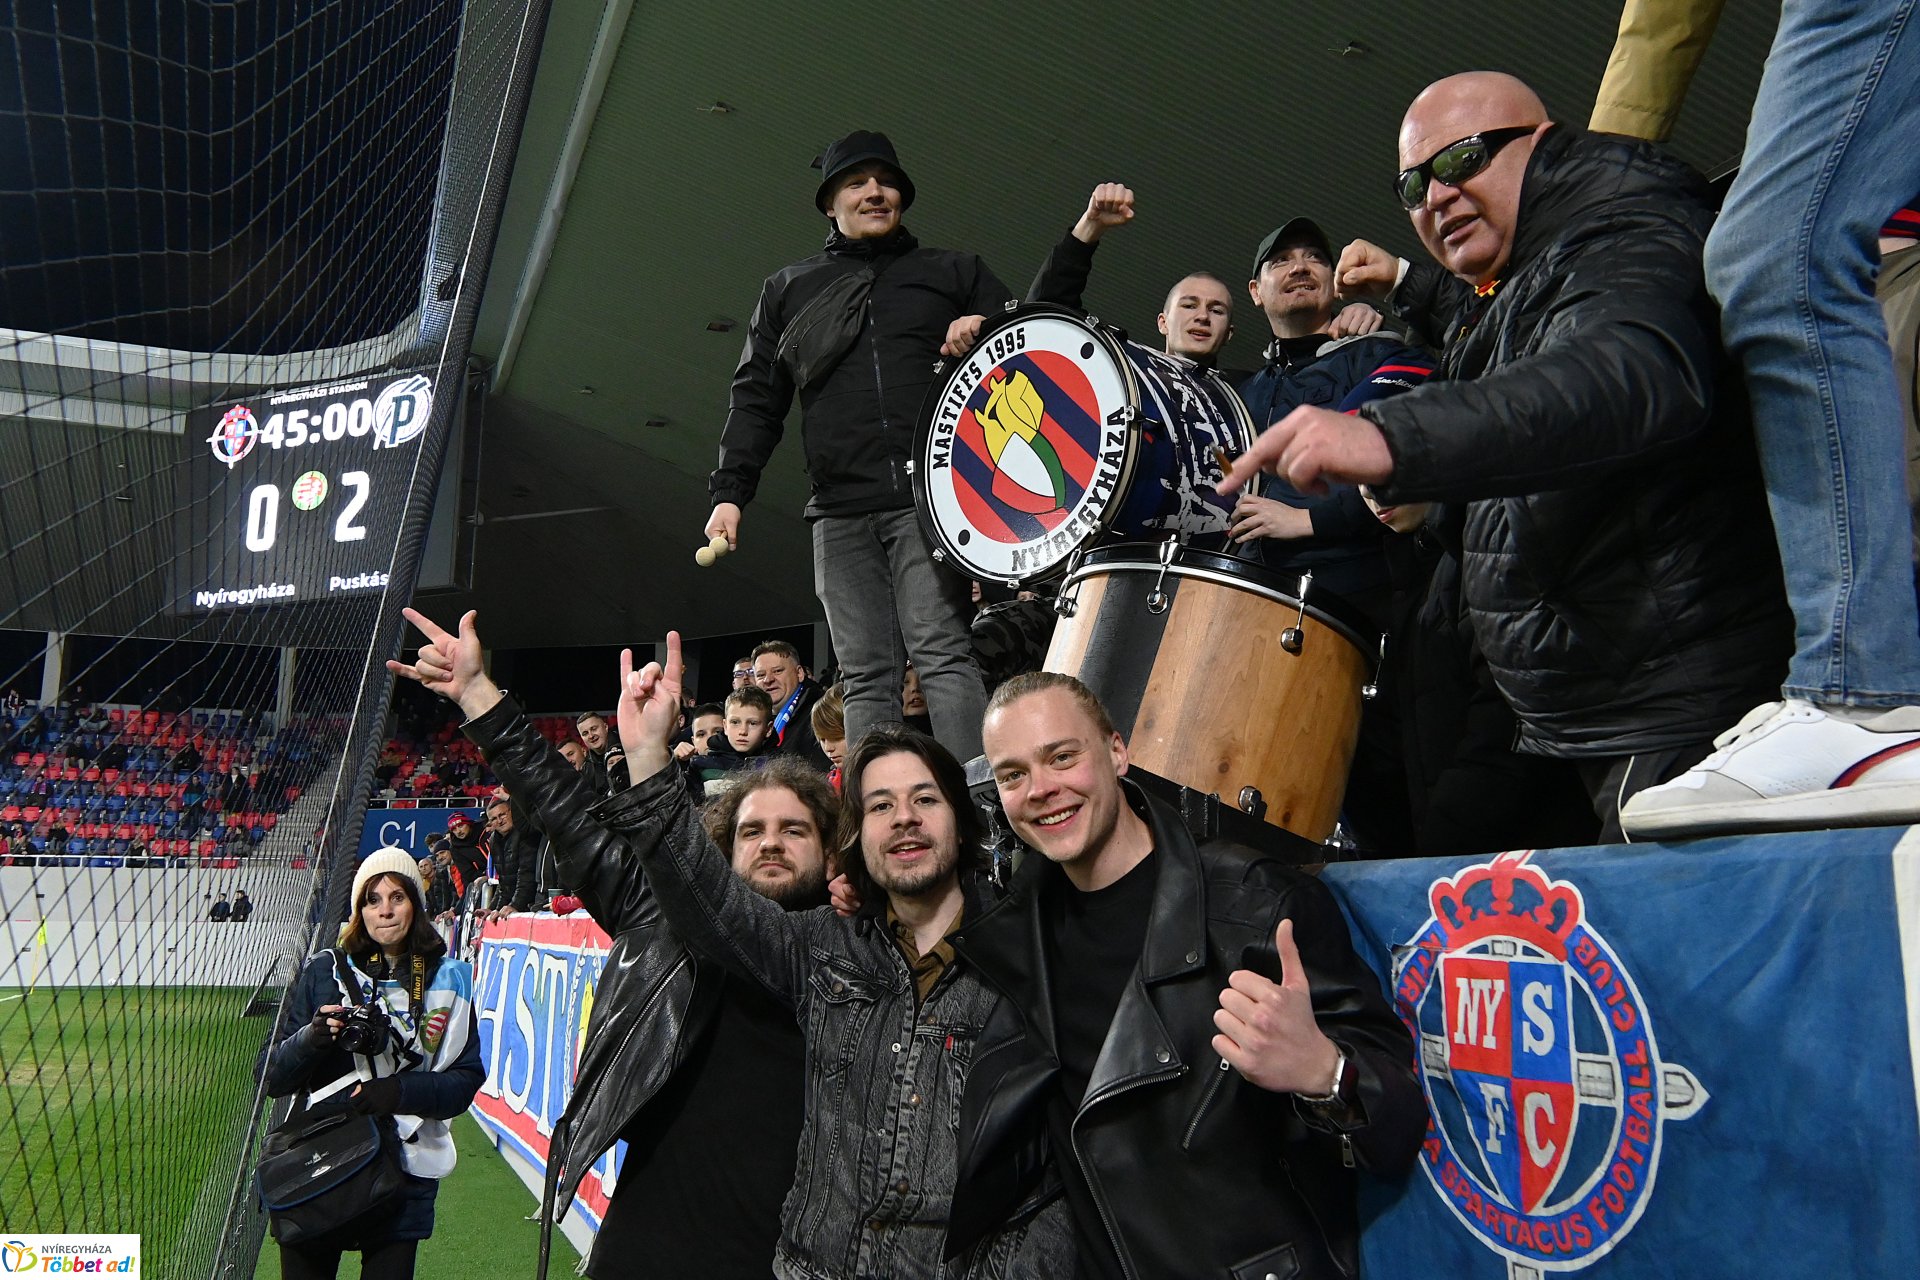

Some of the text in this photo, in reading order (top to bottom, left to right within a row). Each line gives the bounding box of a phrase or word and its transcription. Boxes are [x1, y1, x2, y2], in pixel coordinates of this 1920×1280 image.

[260, 398, 373, 450] 45:00
[270, 381, 369, 406] NYÍREGYHÁZI STADION
[933, 327, 1026, 470] MASTIFFS 1995
[246, 483, 280, 552] 0
[335, 470, 370, 542] 2
[1011, 406, 1127, 572] NYÍREGYHÁZA
[195, 582, 296, 608] Nyíregyháza
[329, 570, 389, 592] Puskás
[379, 819, 416, 849] C1
[413, 976, 421, 1000] Nikon
[1453, 977, 1556, 1056] NY S
[1441, 936, 1653, 1254] SPARTACUS FOOTBALL CLUB
[1479, 1081, 1557, 1168] F C
